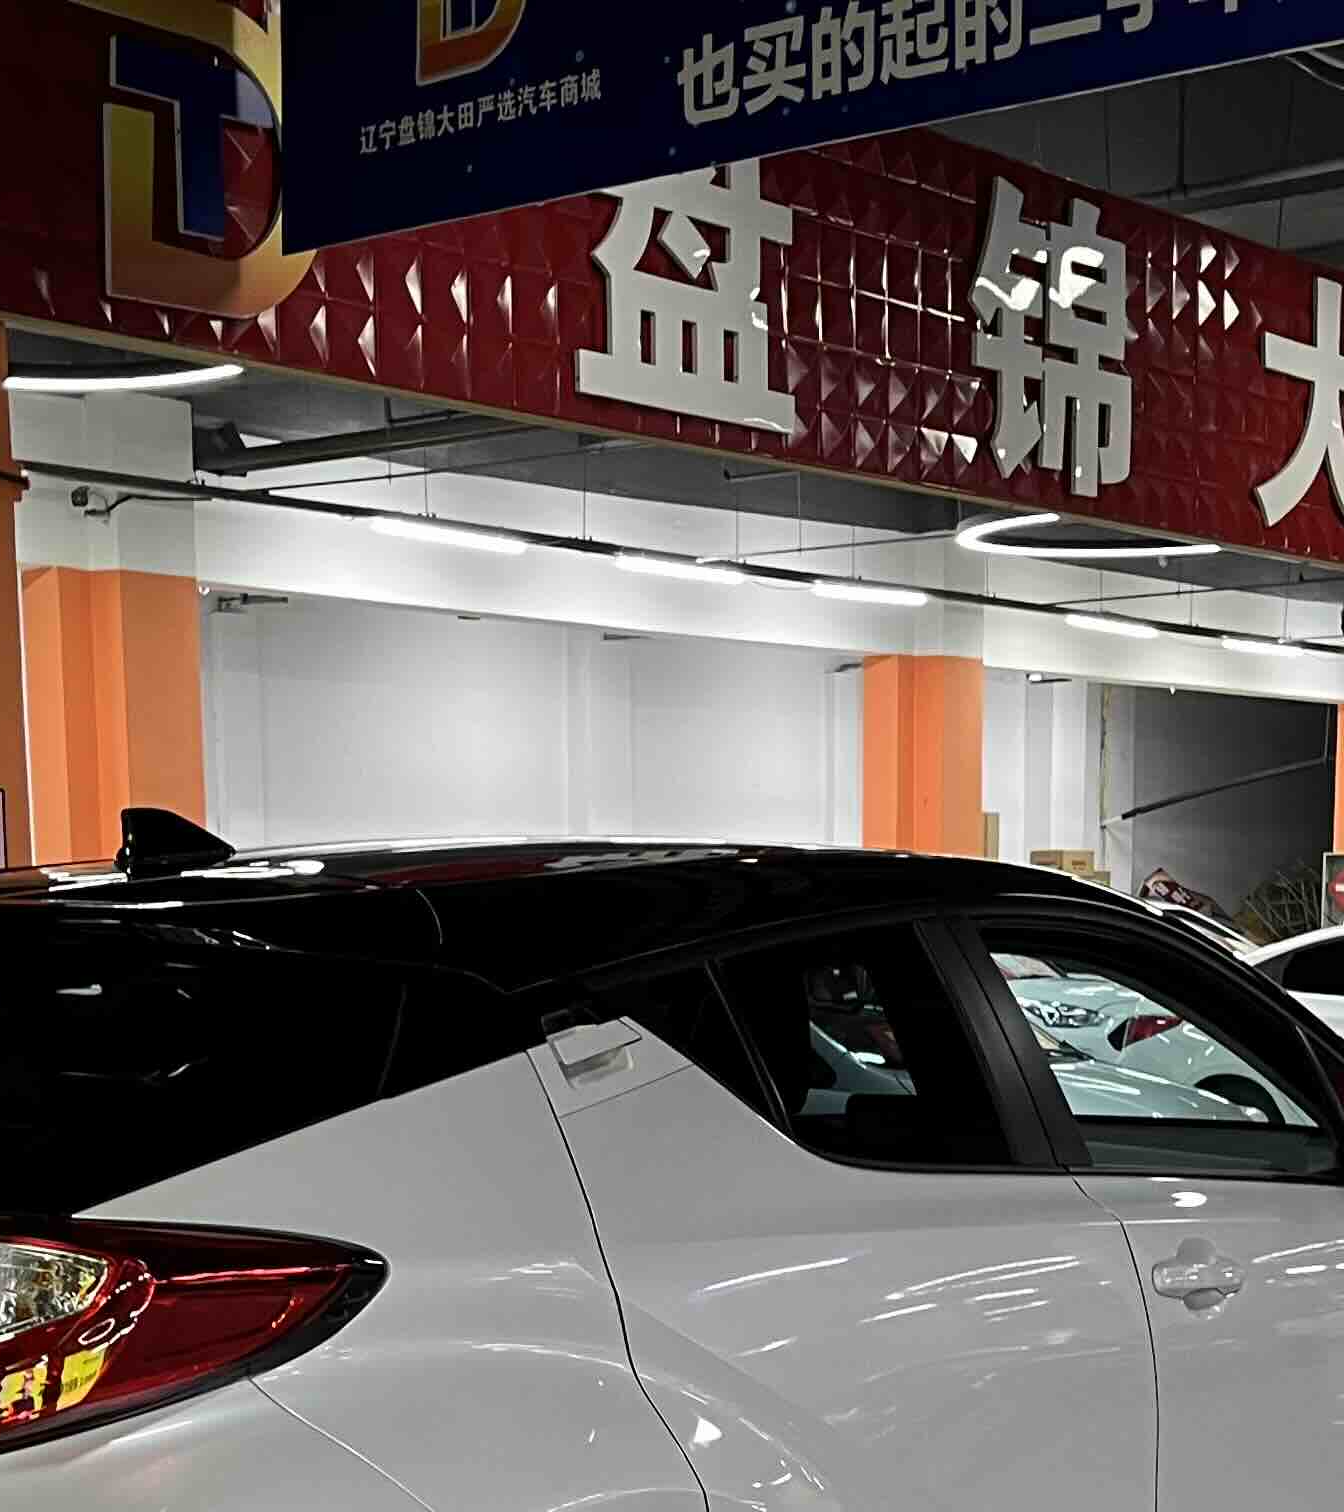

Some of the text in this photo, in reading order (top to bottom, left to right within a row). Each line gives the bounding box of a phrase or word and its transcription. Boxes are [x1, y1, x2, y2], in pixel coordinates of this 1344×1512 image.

[360, 68, 601, 154] 辽宁盘锦大田严选汽车商城
[677, 0, 1250, 127] 也买的起的
